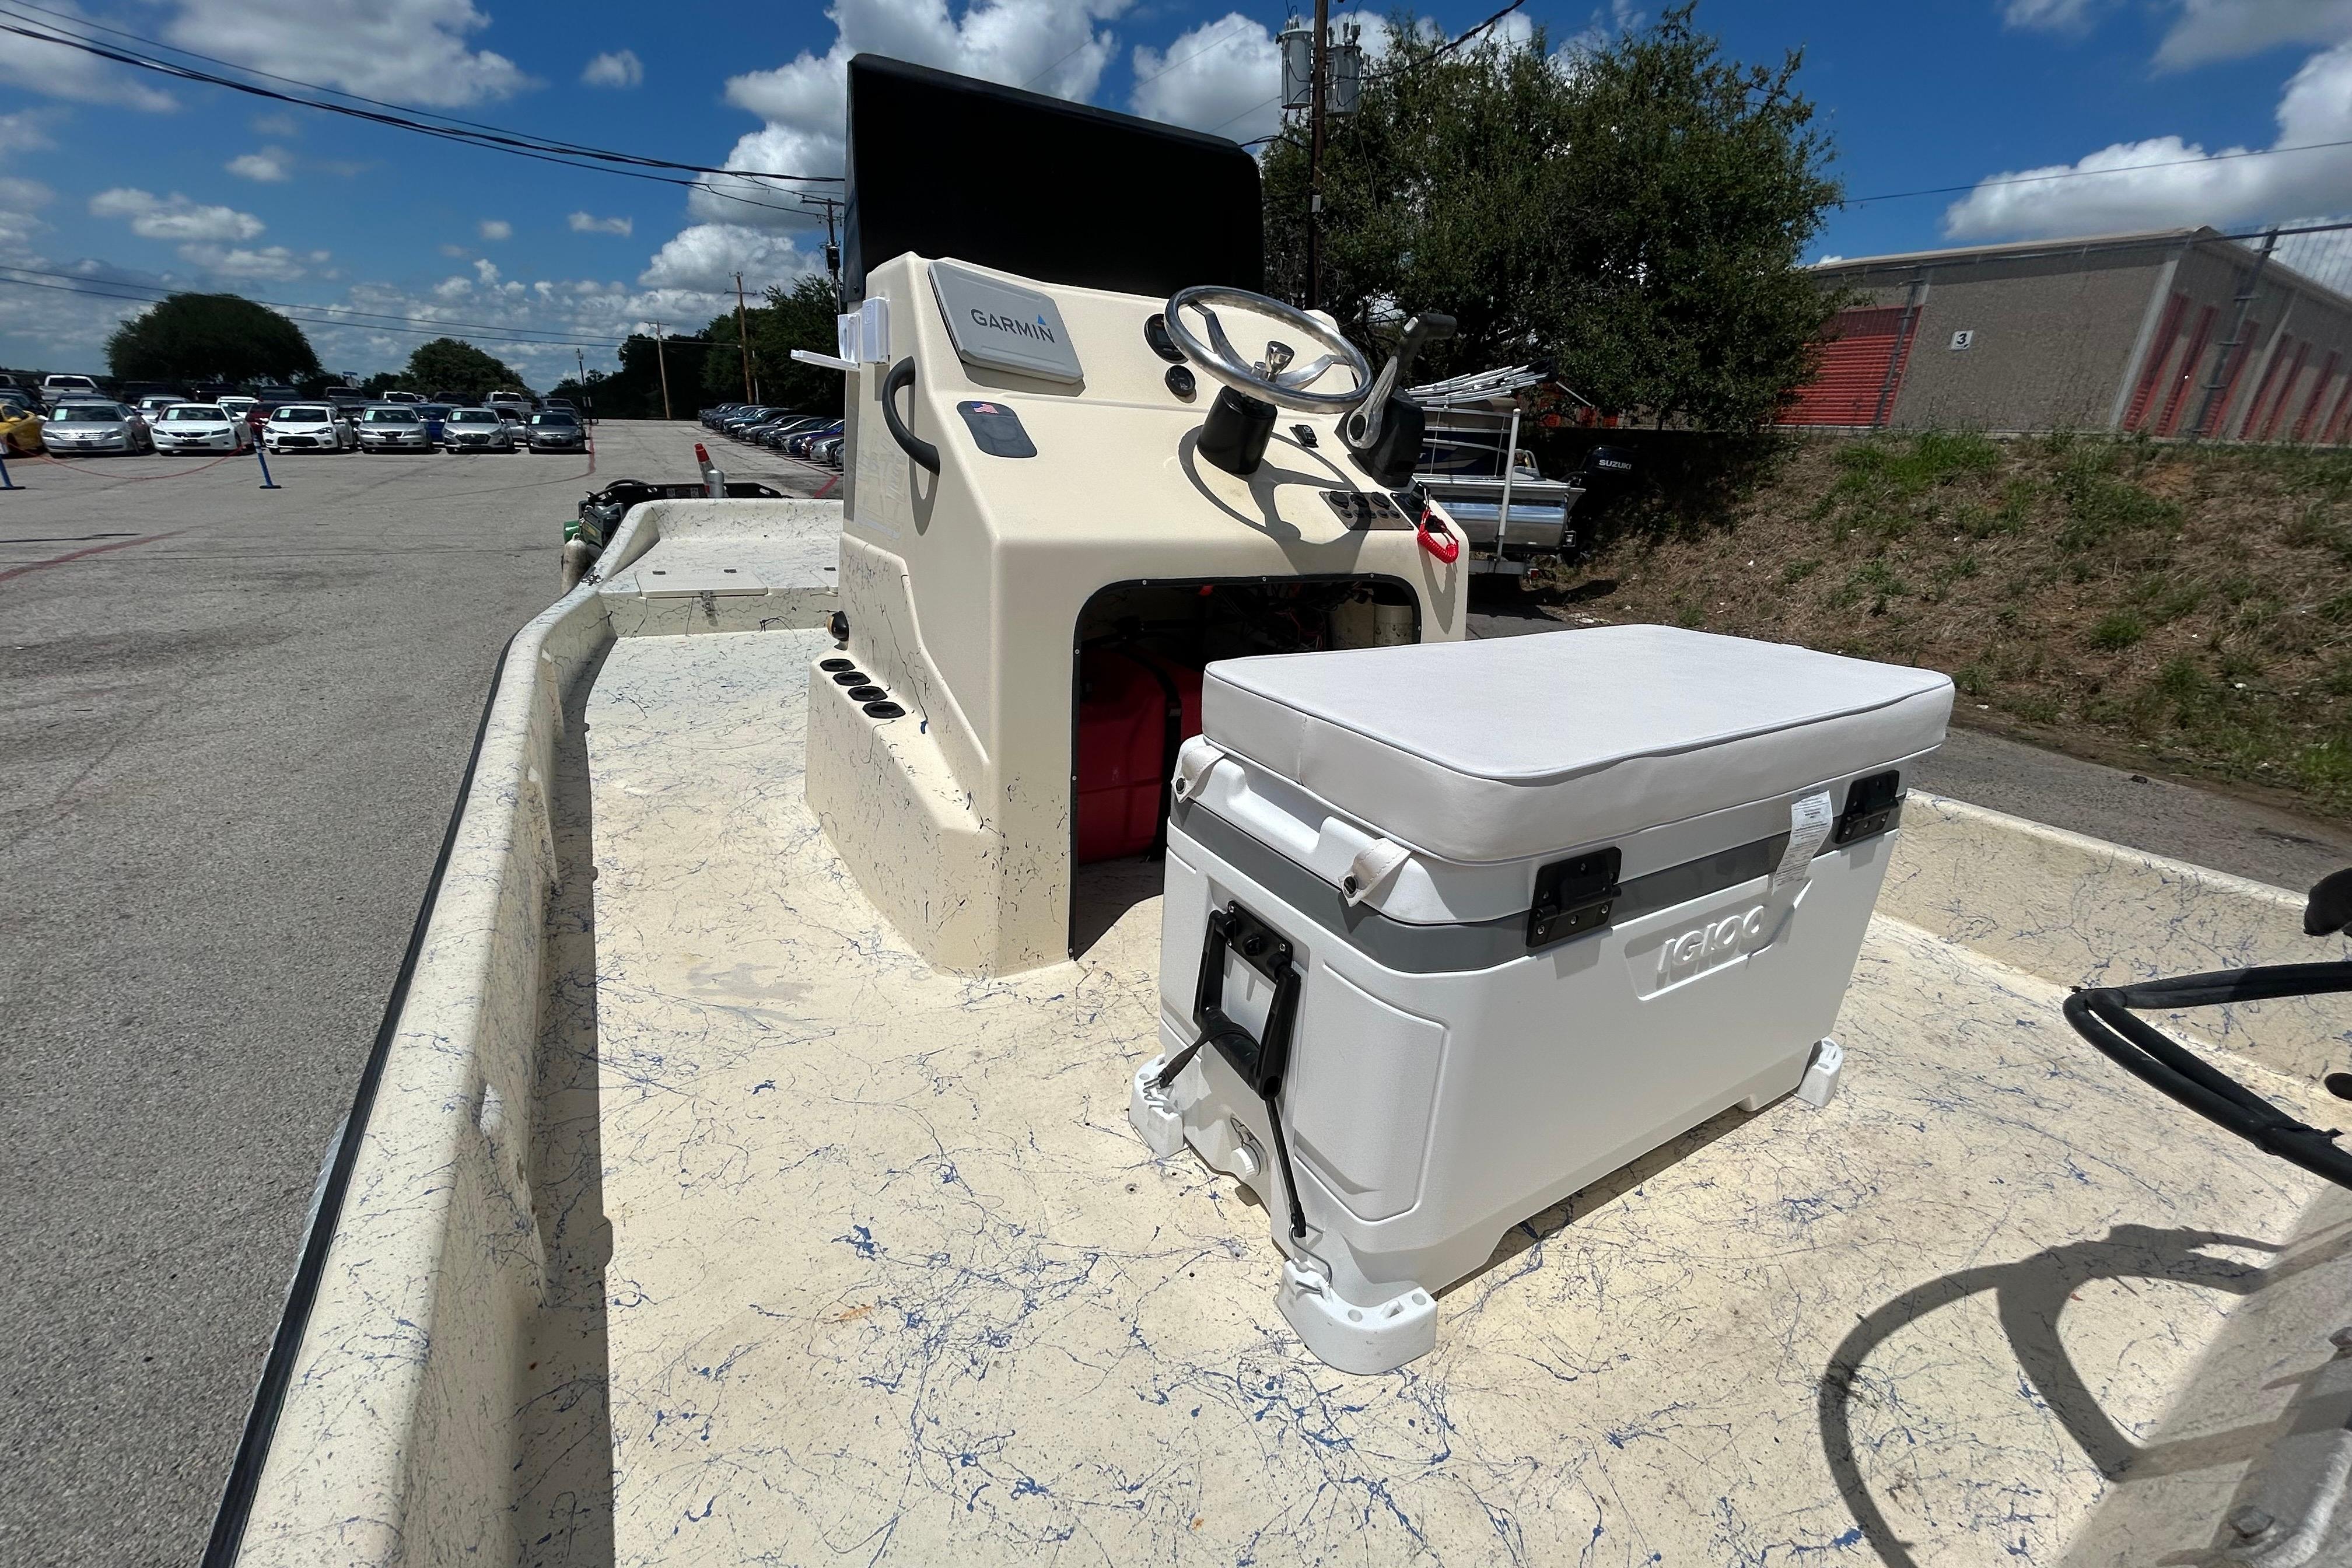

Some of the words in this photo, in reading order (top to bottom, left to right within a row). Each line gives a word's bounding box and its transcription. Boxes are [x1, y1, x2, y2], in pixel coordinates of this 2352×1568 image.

[971, 309, 1055, 343] GARMIN
[1957, 332, 1967, 345] 3
[1599, 459, 1632, 470] SUZUKI
[1657, 905, 1765, 975] IGLOO
